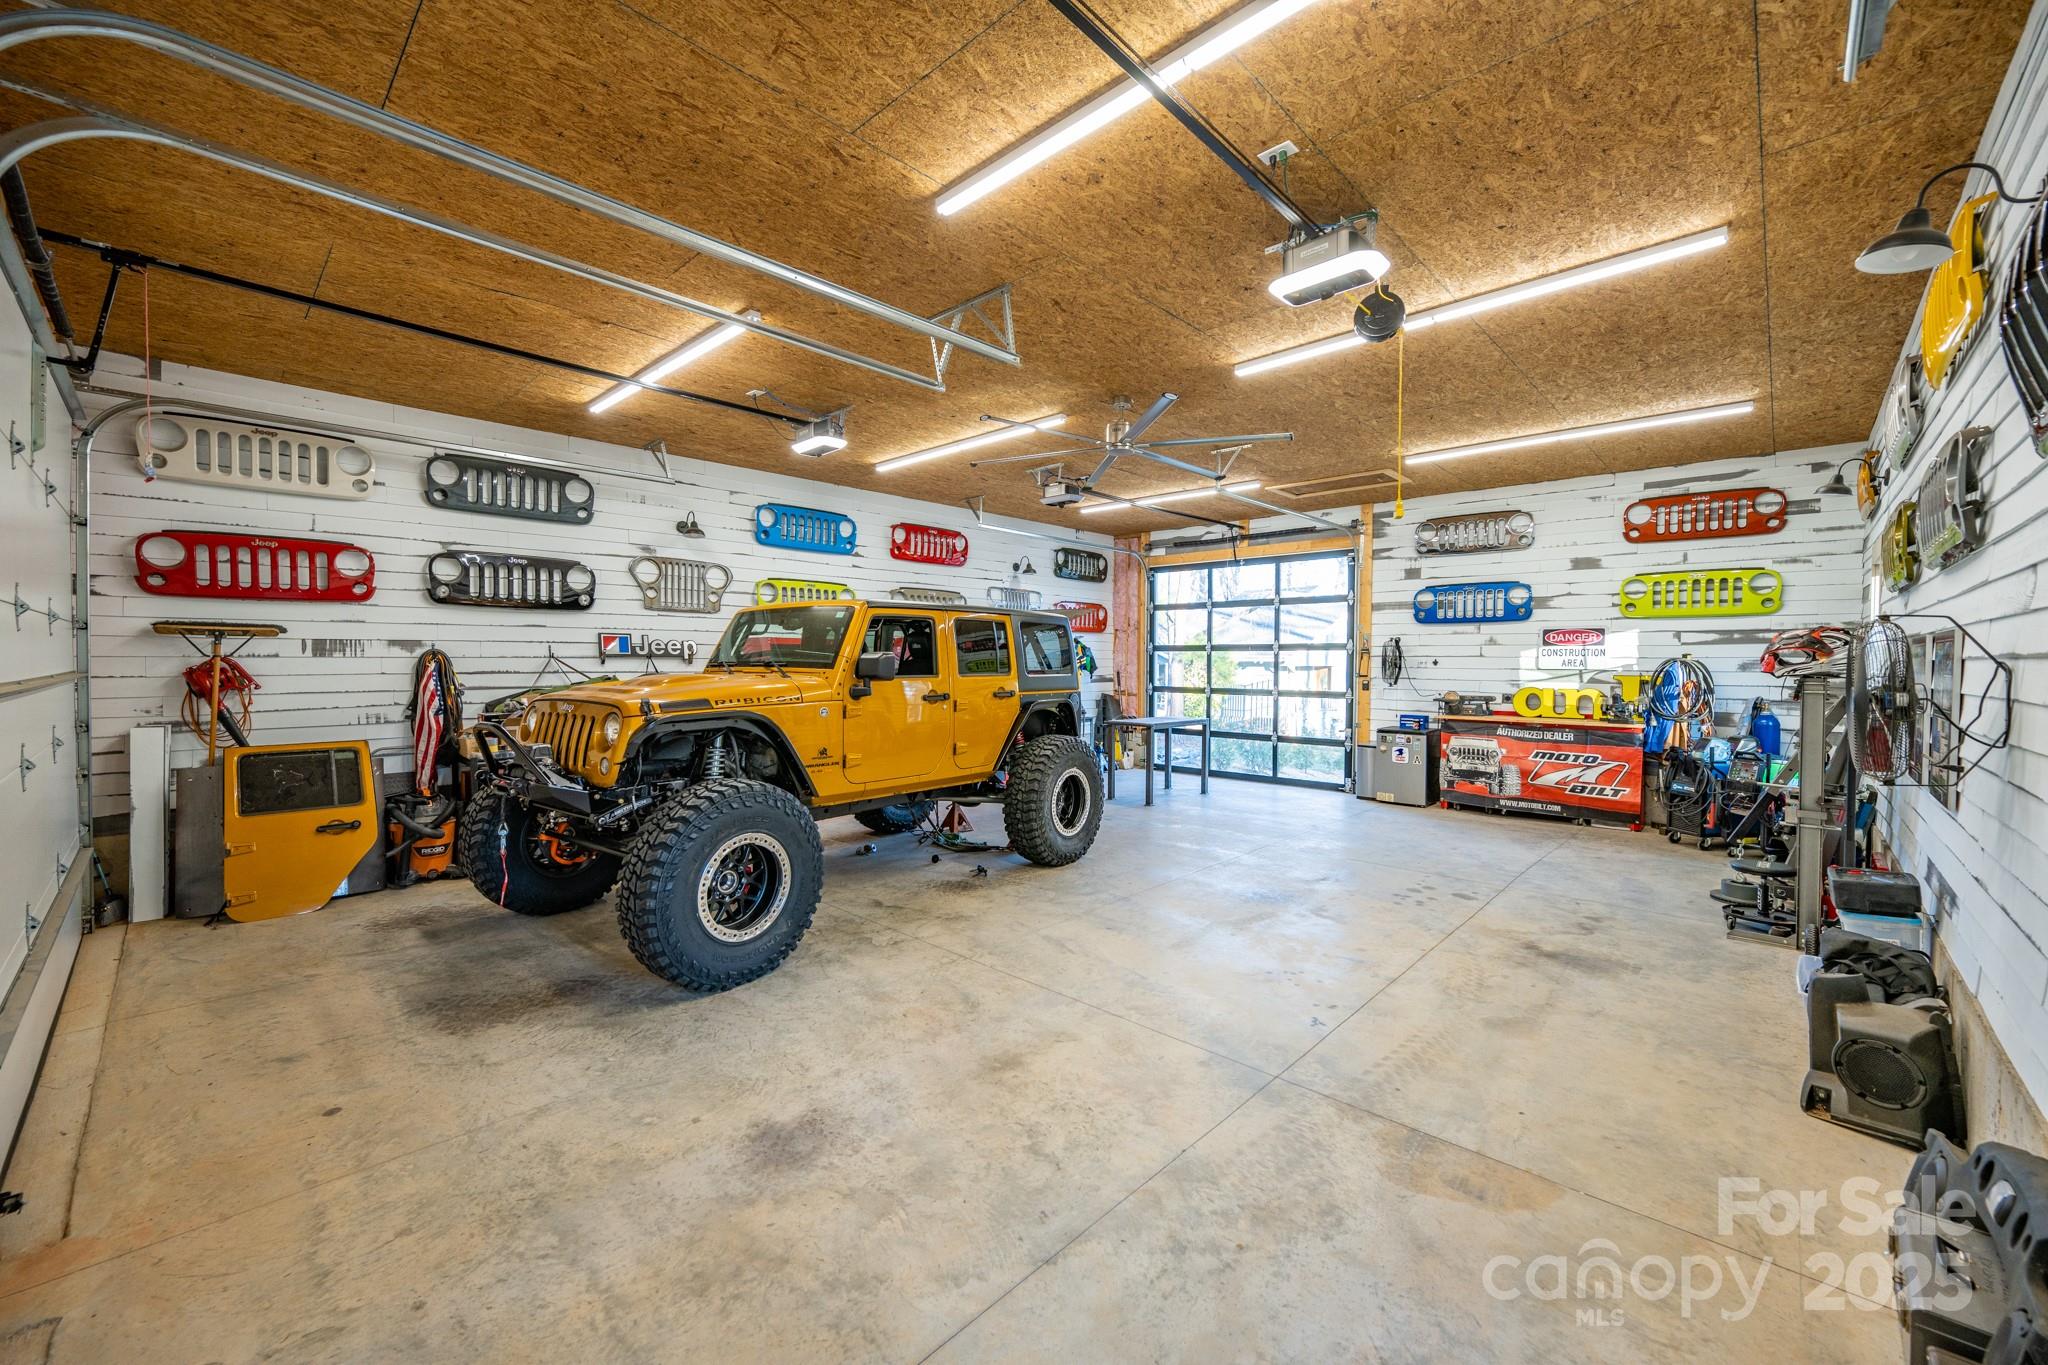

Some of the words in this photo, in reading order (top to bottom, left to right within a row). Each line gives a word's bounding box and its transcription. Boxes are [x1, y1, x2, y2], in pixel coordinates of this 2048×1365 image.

[251, 427, 278, 438] Jeep
[251, 538, 278, 548] Jeep
[508, 556, 528, 565] Jeep
[1550, 631, 1597, 642] DANGER
[635, 634, 698, 660] Jeep
[1541, 648, 1606, 657] CONSTRUCTION
[1561, 659, 1585, 668] AREA
[714, 695, 800, 706] RUBICON
[1496, 727, 1543, 740] AUTHORIZED
[1543, 729, 1574, 741] DEALER
[1530, 750, 1600, 765] MOTO
[1566, 785, 1630, 799] BILT
[1499, 799, 1561, 812] WWW.MOTOBILT.COM
